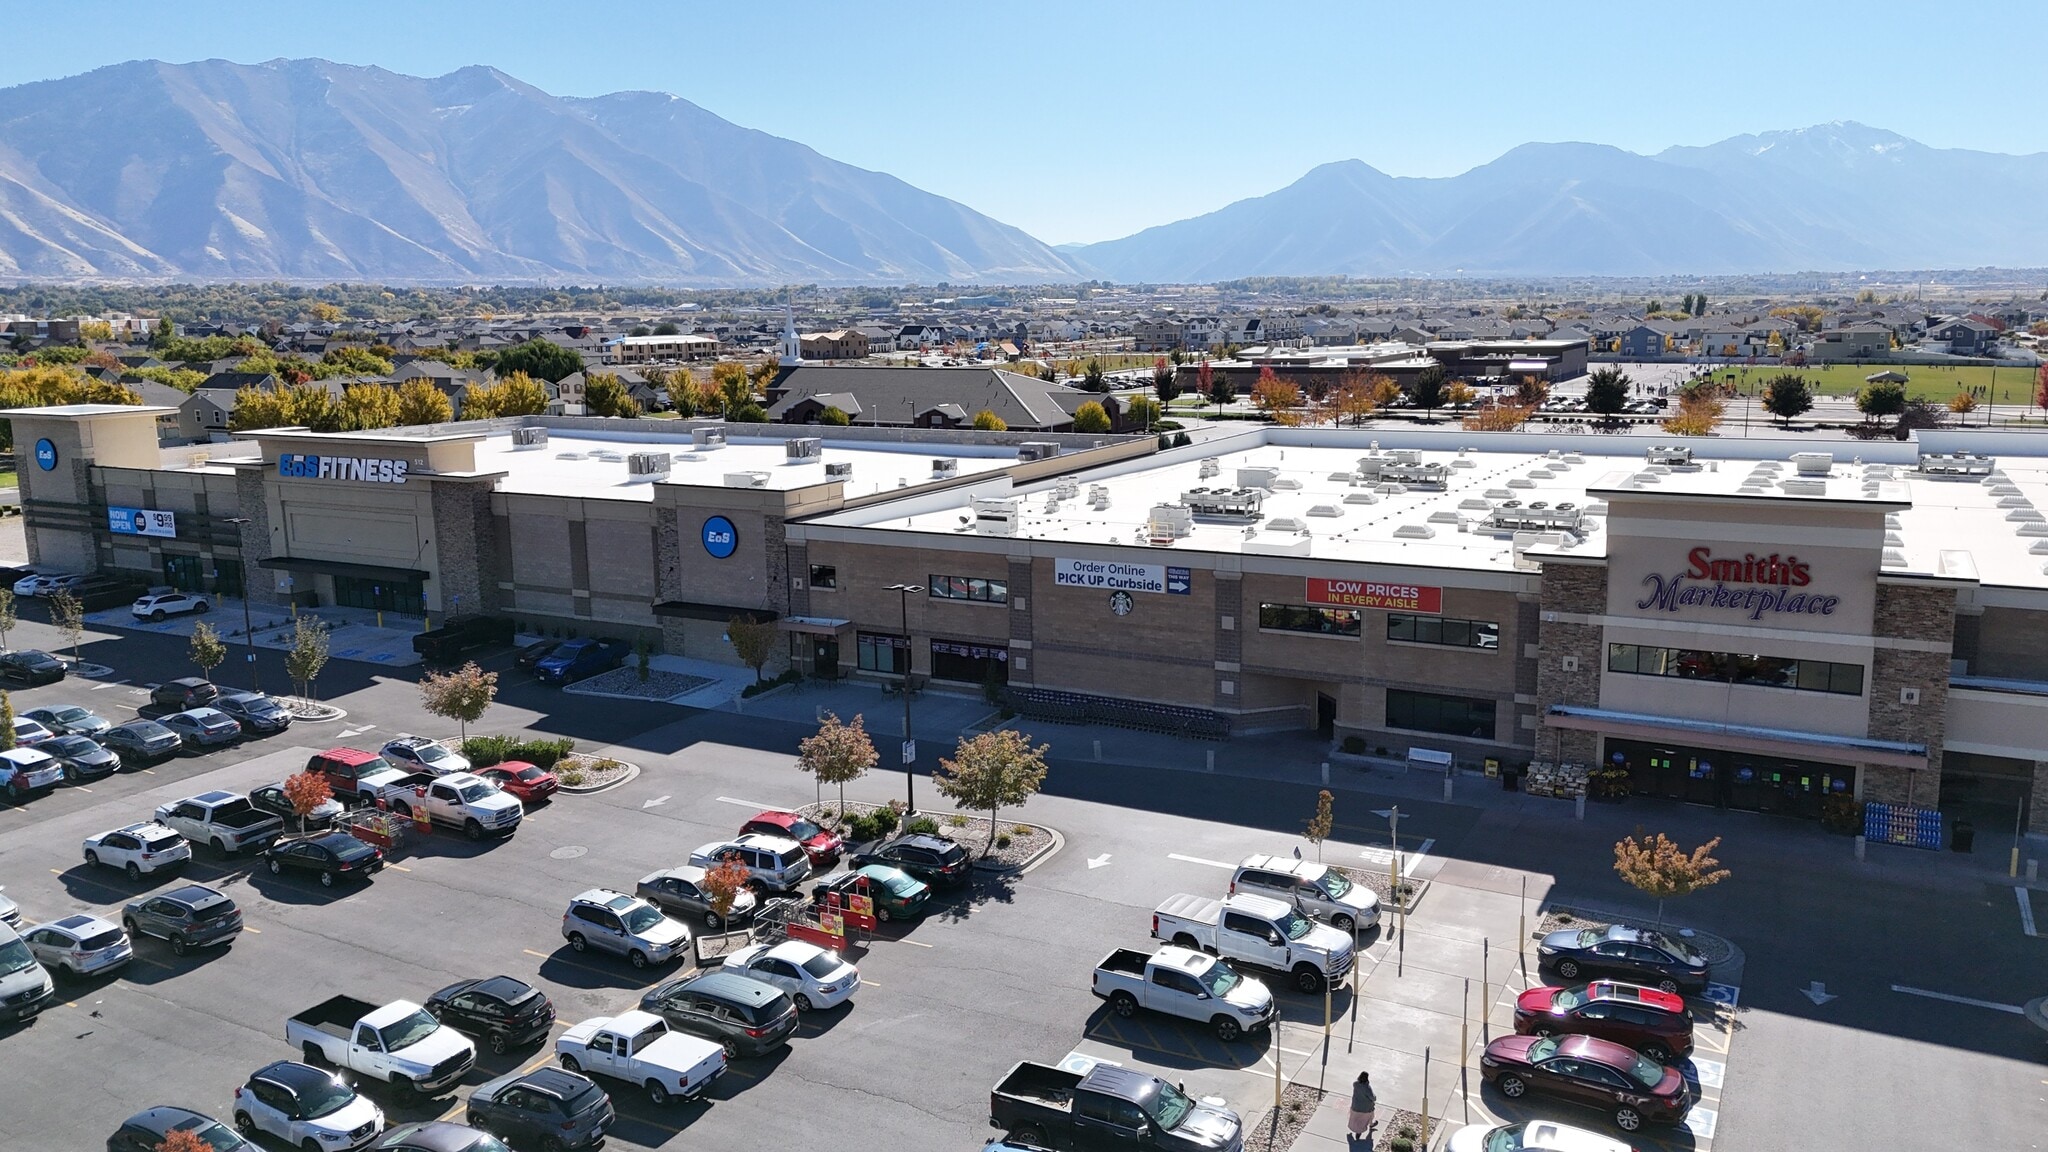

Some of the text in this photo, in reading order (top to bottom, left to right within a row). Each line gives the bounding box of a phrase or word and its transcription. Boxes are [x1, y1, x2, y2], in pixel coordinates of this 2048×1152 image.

[319, 456, 408, 484] FITNESS
[109, 510, 128, 520] NOW
[111, 520, 131, 530] OPEN
[1073, 561, 1146, 577] Order Online
[1686, 547, 1811, 587] Smith's
[1057, 572, 1162, 591] PICK UP Curbside
[1327, 581, 1419, 599] LOW PRICES
[1328, 593, 1418, 609] IN EVERY AISLE
[1637, 572, 1840, 621] Marketplace
